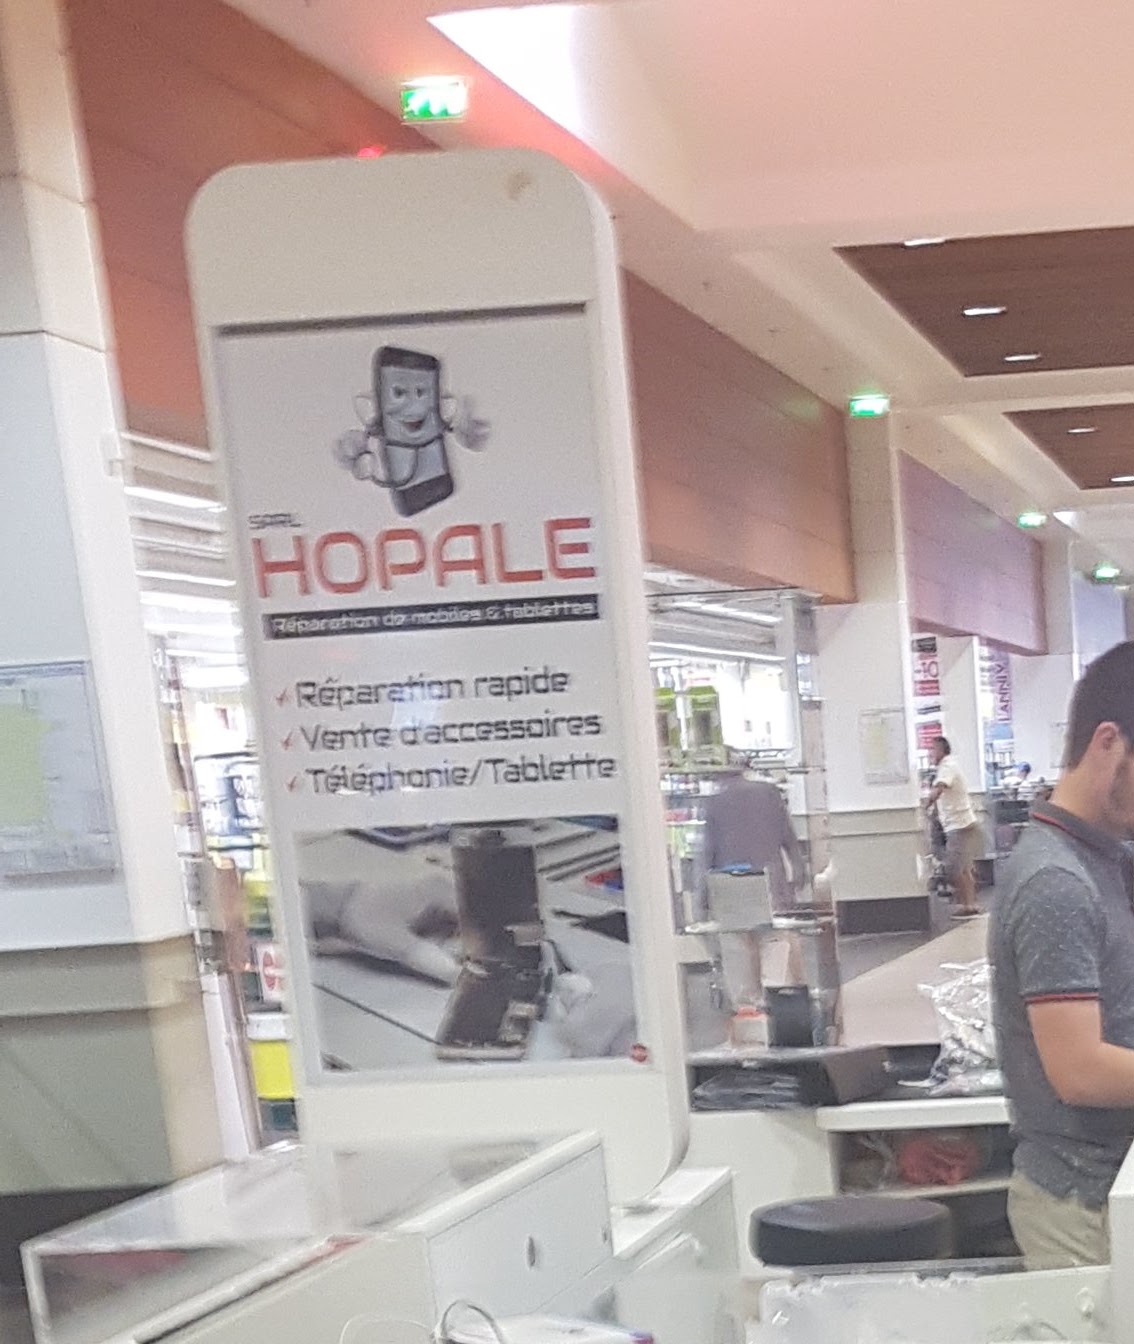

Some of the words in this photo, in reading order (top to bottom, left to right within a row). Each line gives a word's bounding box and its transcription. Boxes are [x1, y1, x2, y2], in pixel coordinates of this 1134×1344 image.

[252, 517, 596, 598] HOPALE
[272, 611, 379, 635] Réparation
[384, 609, 403, 626] de
[410, 604, 482, 624] mobiles
[485, 605, 500, 620] &
[504, 600, 595, 619] tablettes
[296, 672, 464, 711] Réparation
[474, 666, 570, 702] rapide
[300, 722, 392, 751] Vente
[401, 710, 603, 747] d'accessoires
[306, 753, 617, 796] Téléphonie/Tablette
